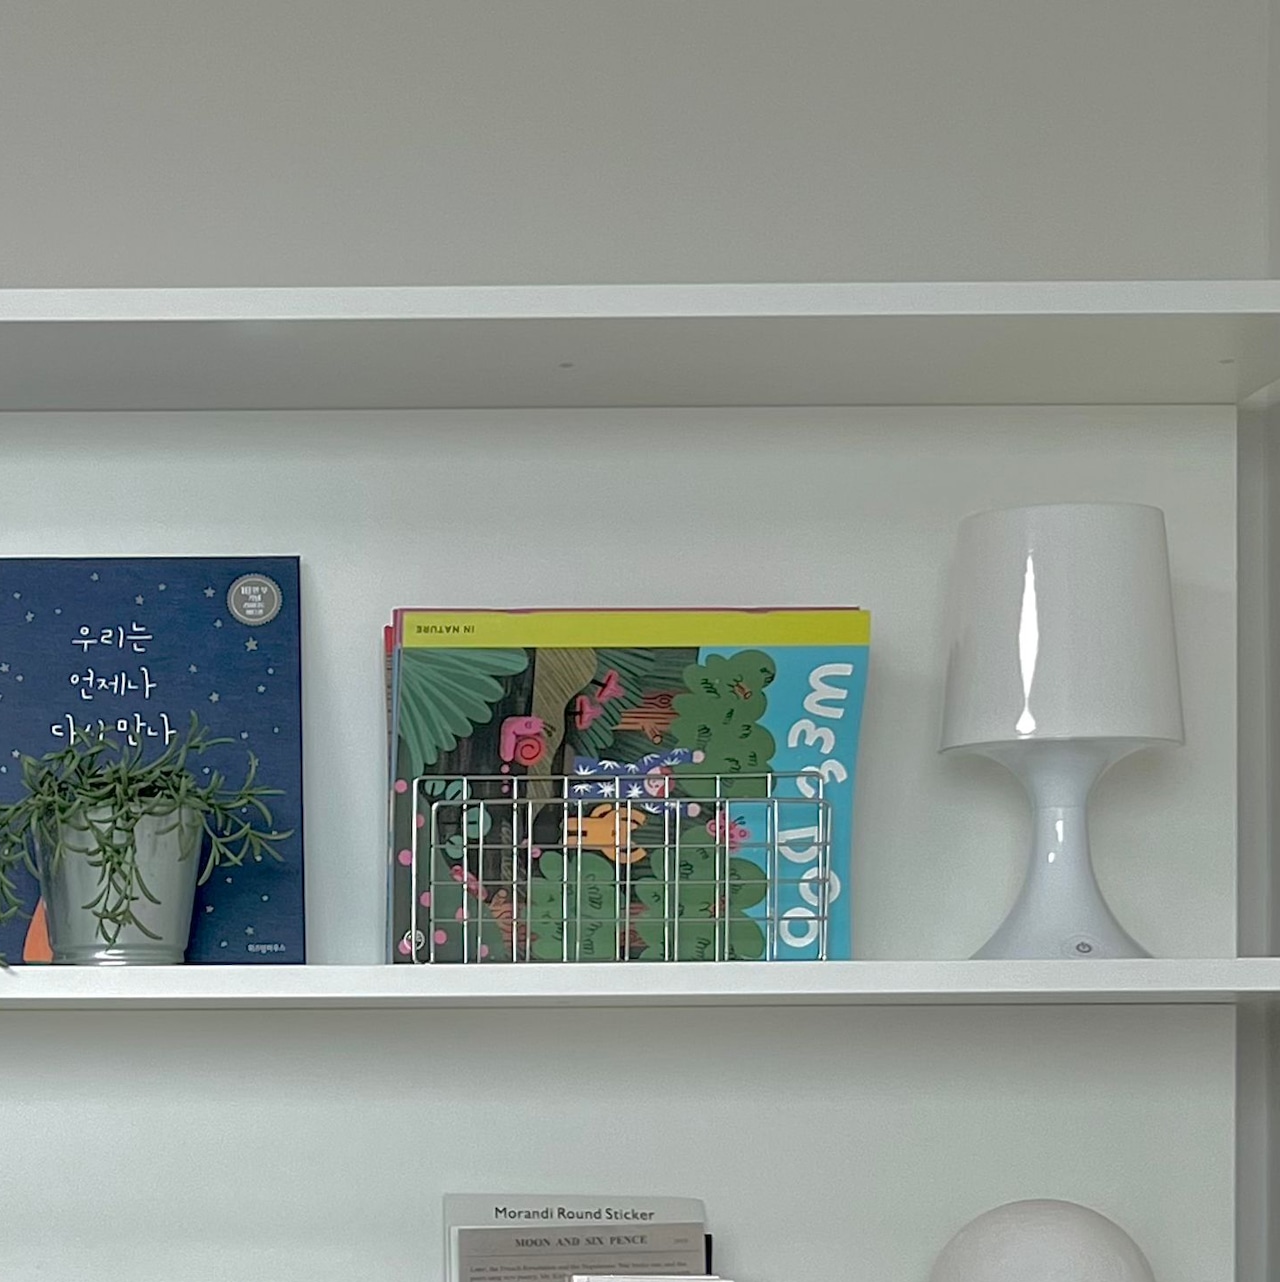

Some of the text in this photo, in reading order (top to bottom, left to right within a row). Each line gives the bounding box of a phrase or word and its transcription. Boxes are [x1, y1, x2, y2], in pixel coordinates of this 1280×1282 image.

[415, 624, 475, 634] IN NATURE
[71, 621, 153, 653] 우리는
[70, 666, 158, 700] 언제나
[494, 1206, 655, 1221] Morandi Round Sticker
[515, 1234, 648, 1248] MOON AND SIX PENCE
